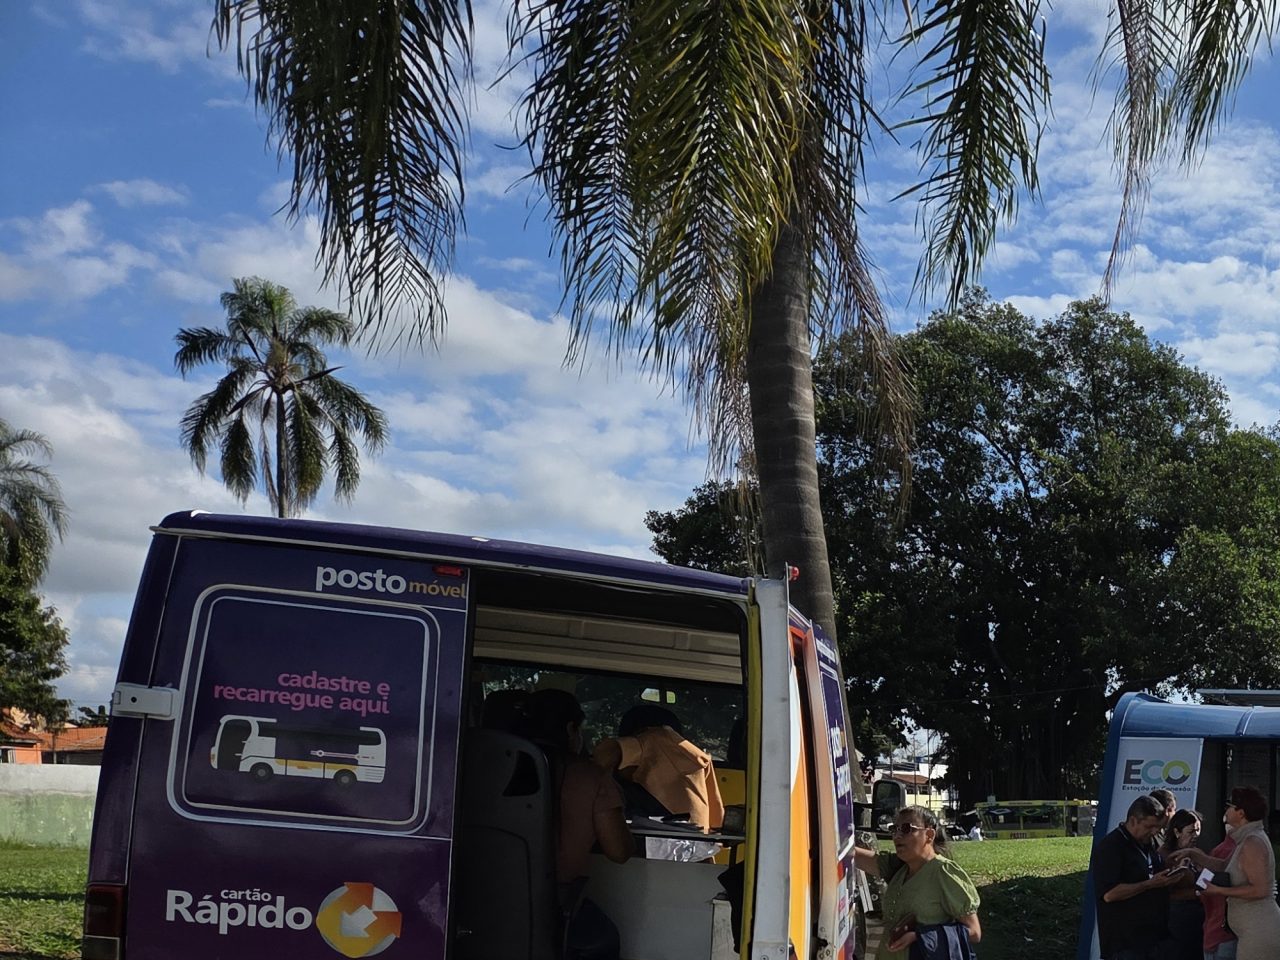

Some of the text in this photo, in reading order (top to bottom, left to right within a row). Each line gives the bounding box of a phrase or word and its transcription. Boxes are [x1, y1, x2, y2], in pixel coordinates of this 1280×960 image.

[315, 566, 466, 598] posto móvel
[278, 671, 391, 696] cadastre e
[214, 685, 390, 717] recarregue aqui
[1123, 759, 1191, 785] ECO
[220, 888, 272, 902] cartão
[165, 889, 313, 935] Rápido
